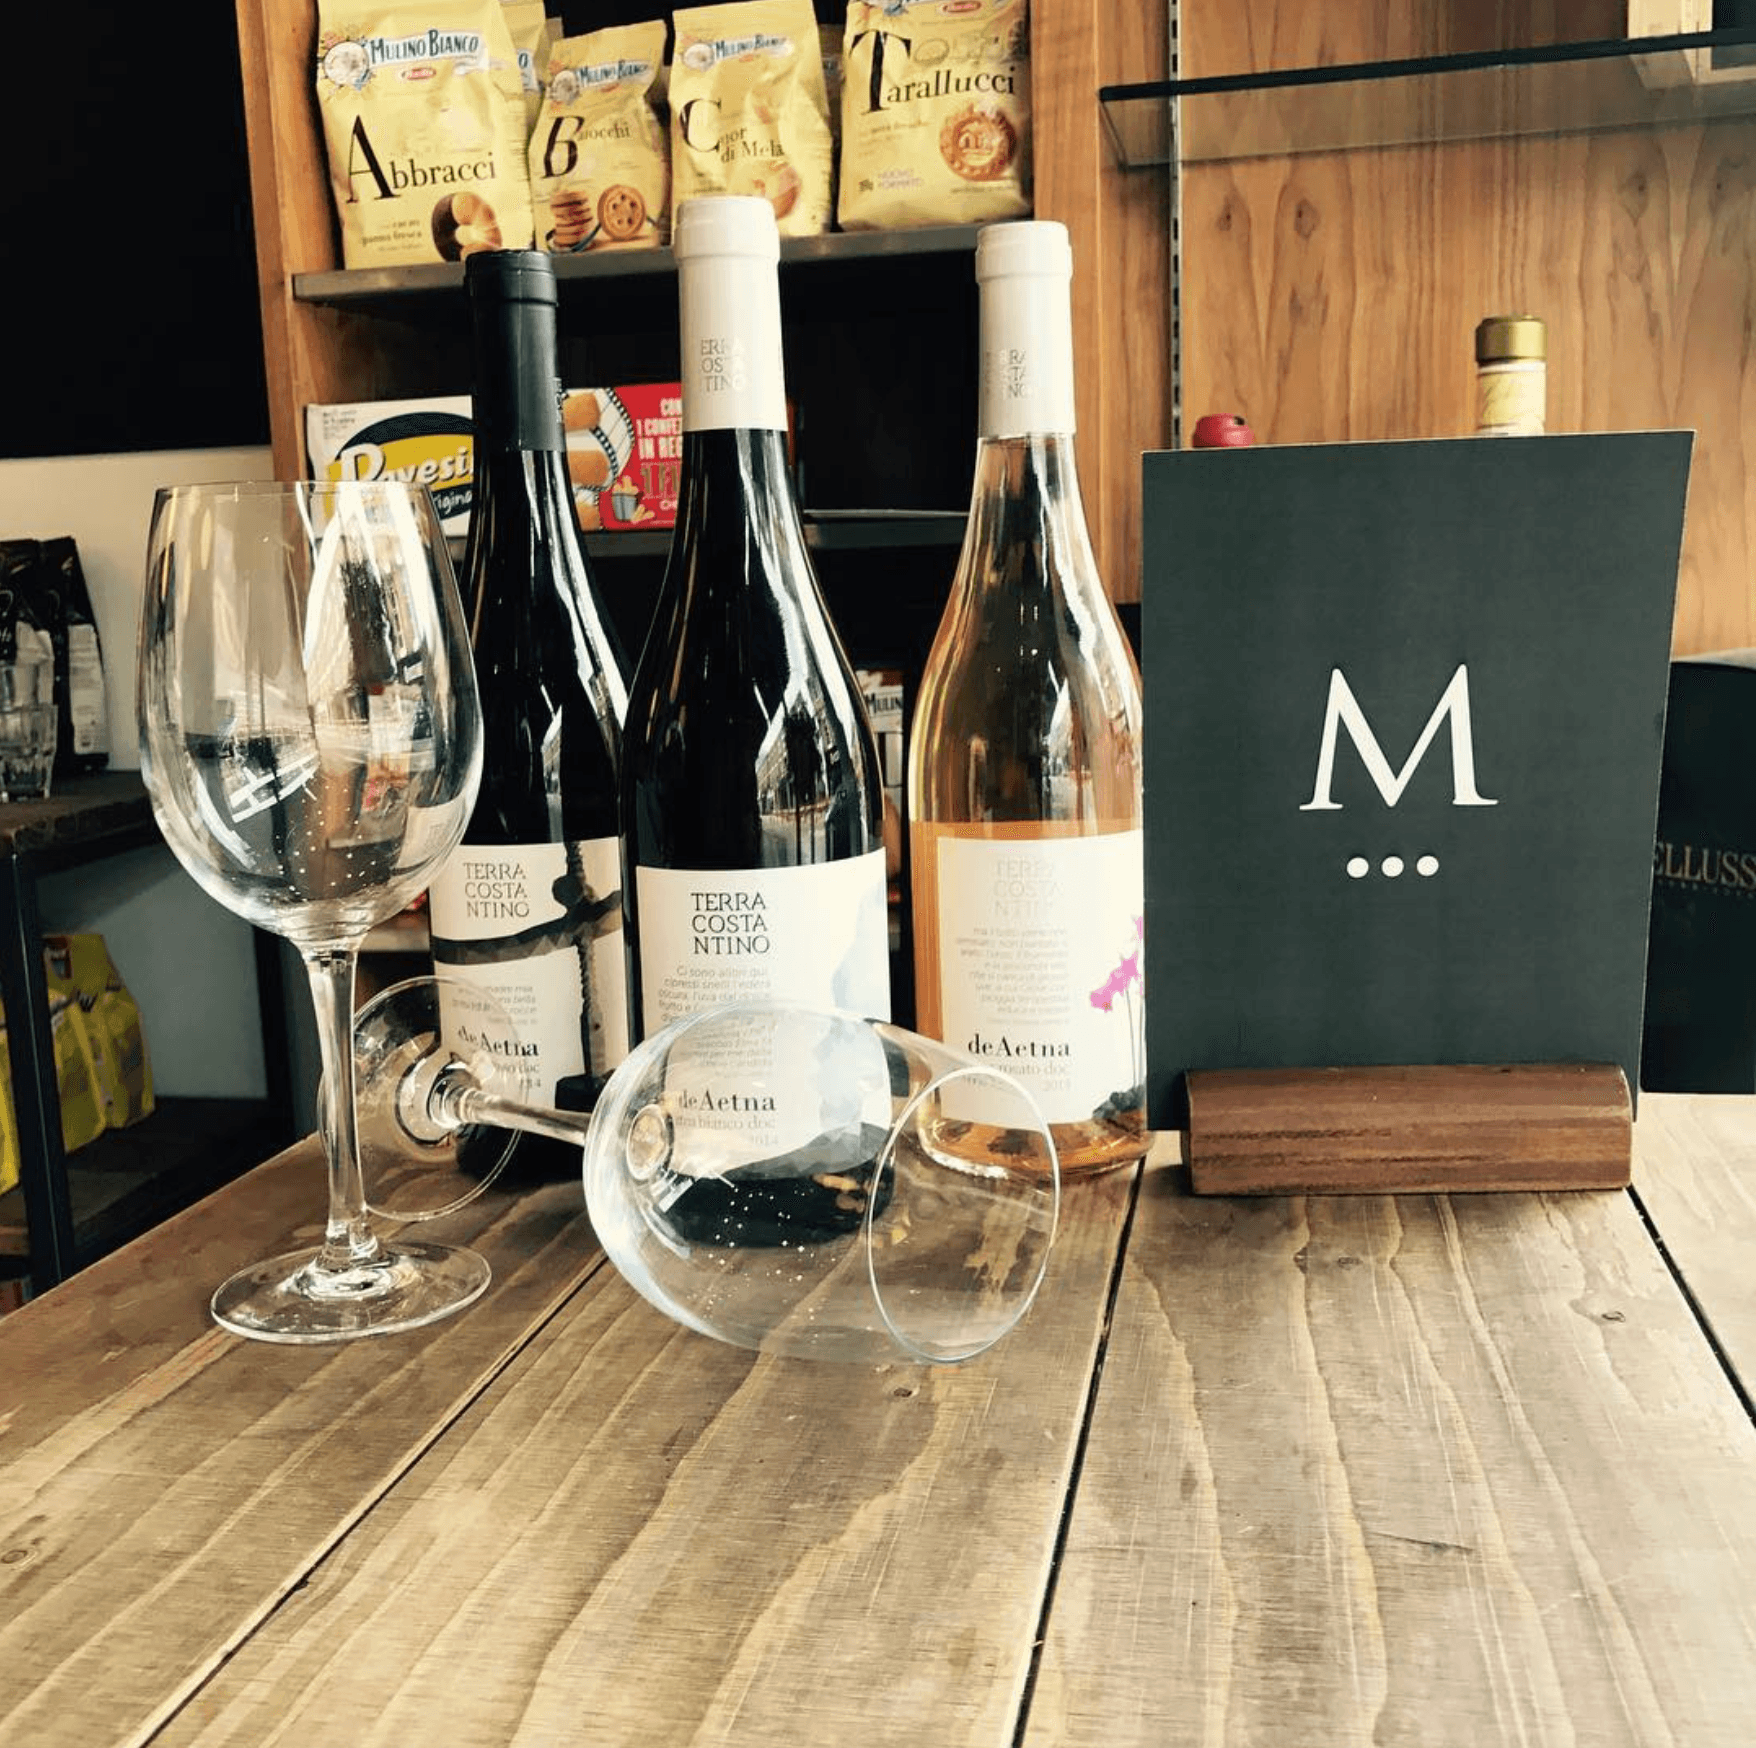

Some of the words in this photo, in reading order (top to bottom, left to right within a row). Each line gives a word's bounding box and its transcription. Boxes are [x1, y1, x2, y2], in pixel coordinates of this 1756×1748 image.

[428, 29, 479, 57] BIANCO
[849, 29, 1015, 115] Tarallucci
[345, 114, 497, 203] Abbracci
[721, 145, 735, 163] di
[742, 139, 785, 158] Mela
[1299, 663, 1498, 811] M
[463, 862, 527, 881] TERRA
[464, 881, 529, 900] COSTA
[690, 891, 767, 912] TERRA
[466, 901, 531, 919] NTINO
[692, 913, 768, 934] COSTA
[693, 934, 771, 955] NTINO
[967, 1032, 1071, 1058] deAetna
[678, 1089, 776, 1112] deAetna
